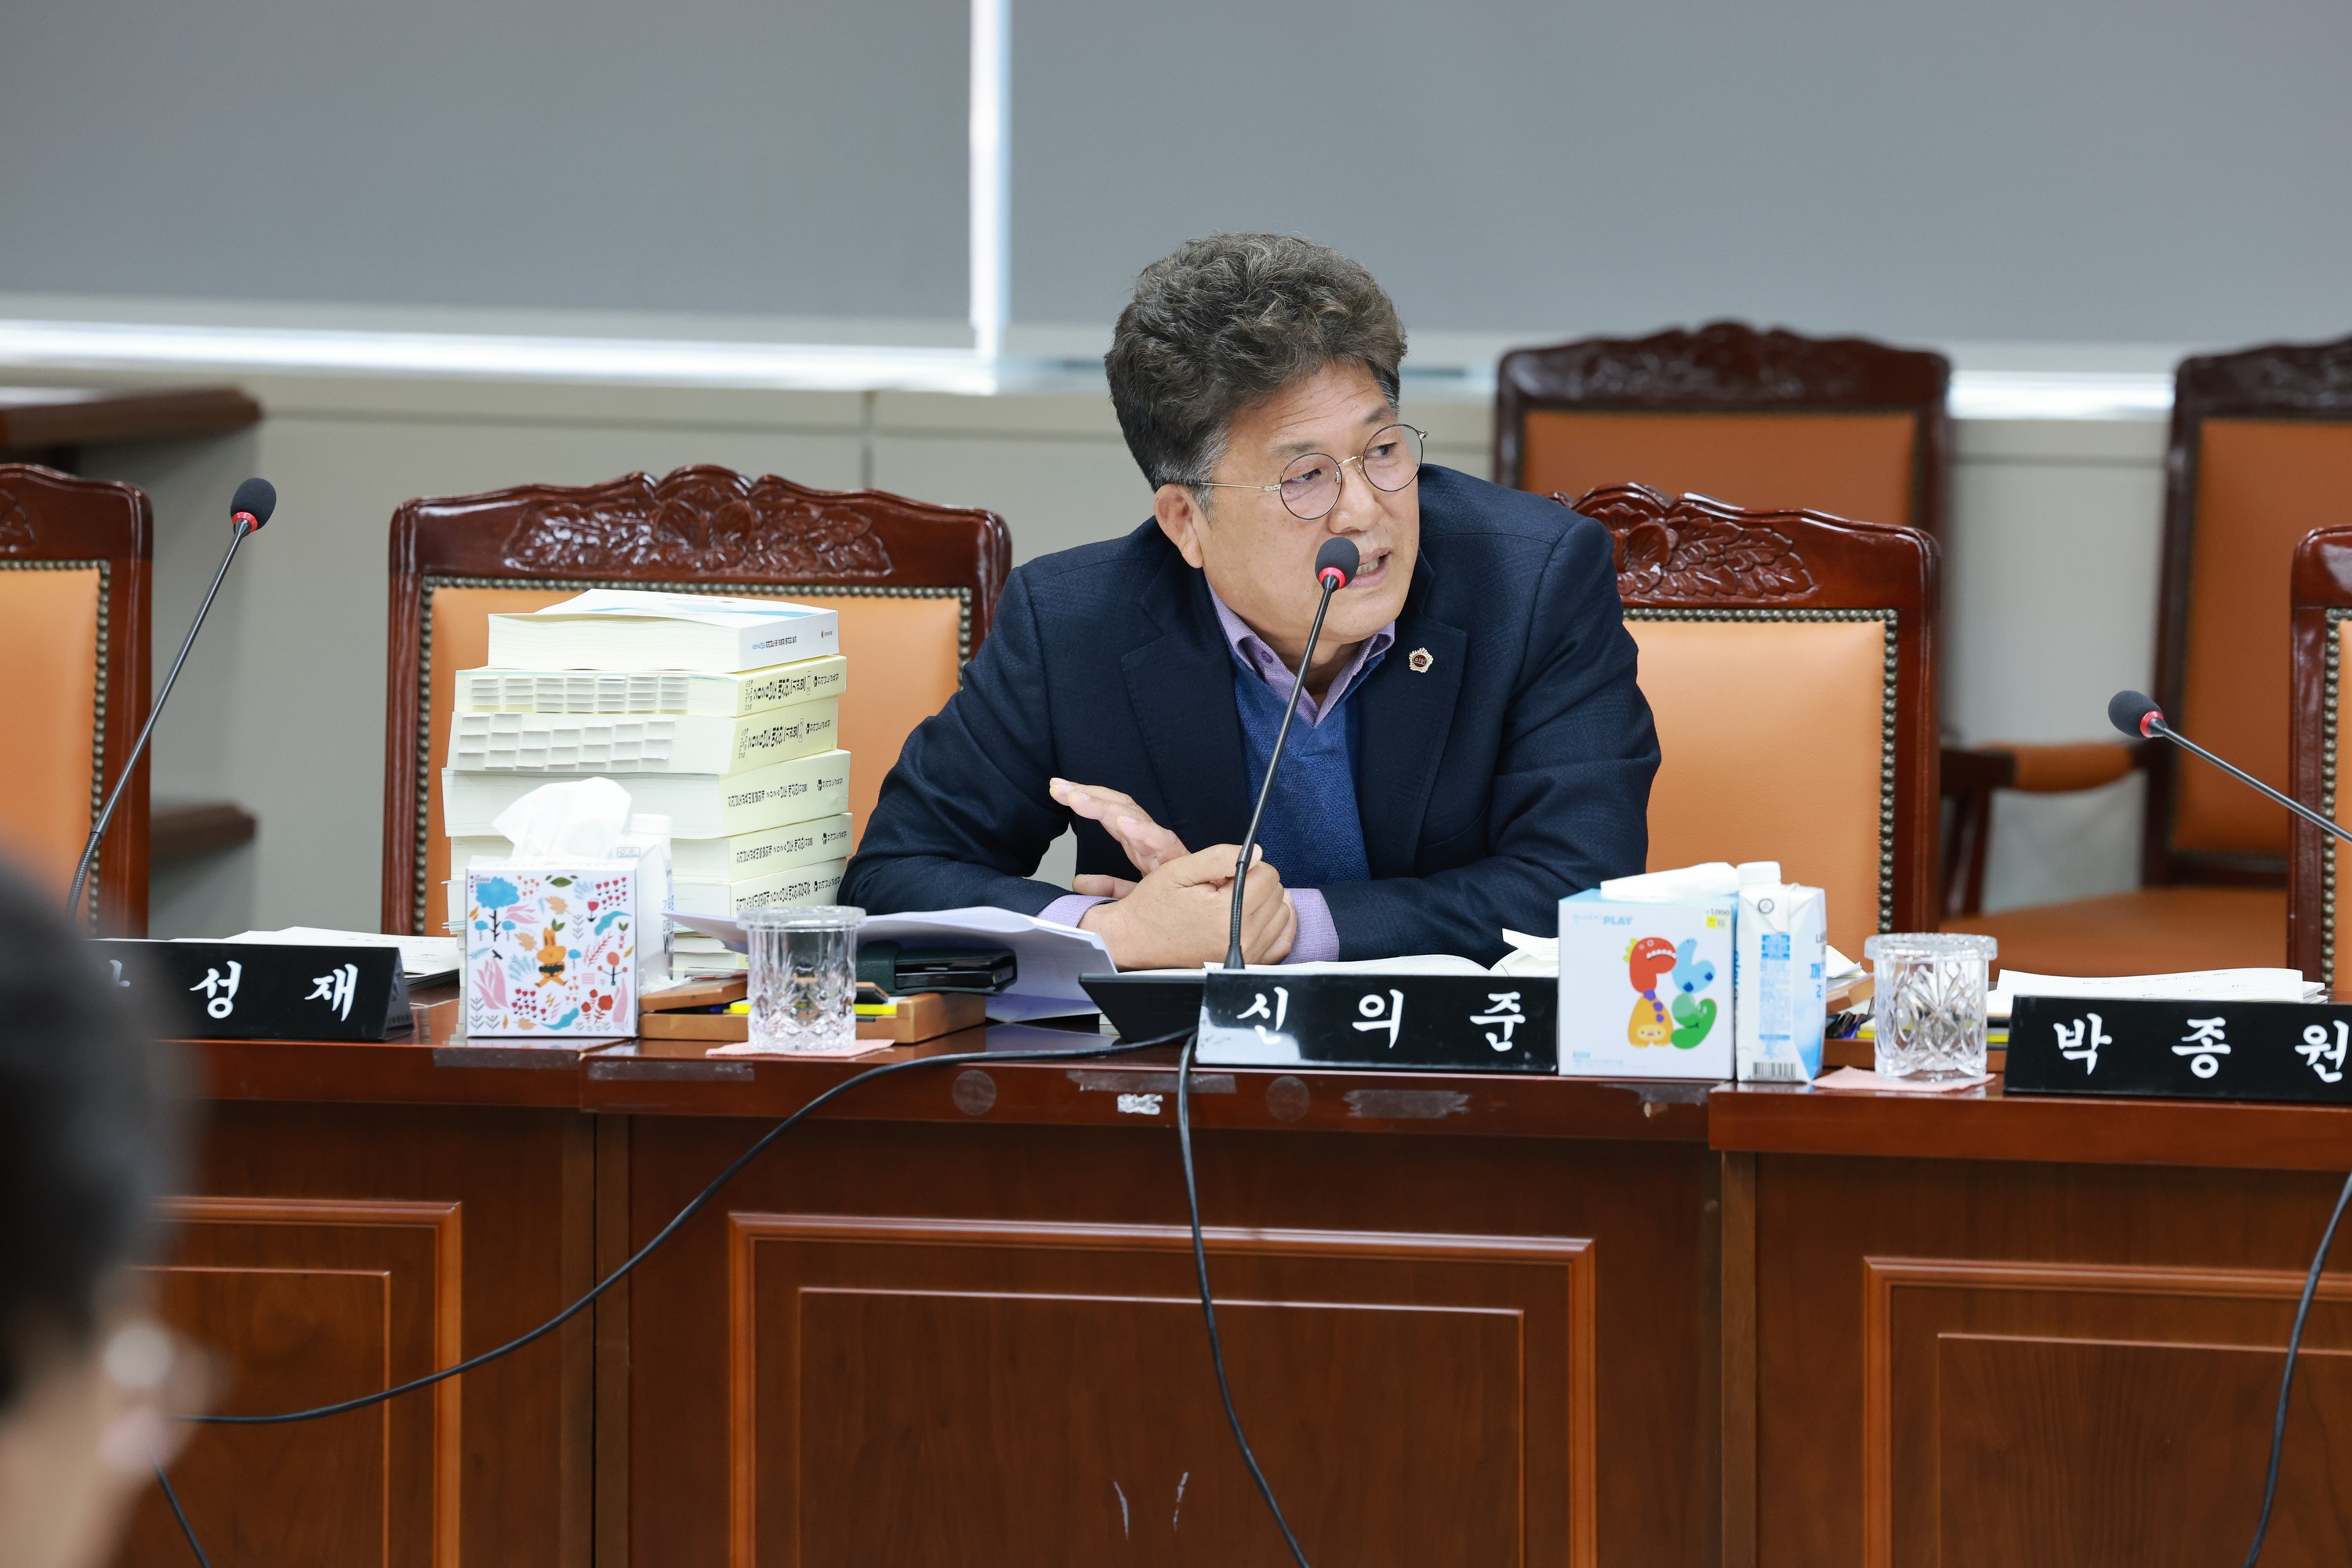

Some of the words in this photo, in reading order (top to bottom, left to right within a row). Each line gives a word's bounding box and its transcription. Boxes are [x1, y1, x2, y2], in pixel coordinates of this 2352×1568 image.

[1603, 916, 1632, 925] PLAY
[189, 960, 242, 1019] 성
[304, 964, 358, 1022] 재
[1236, 986, 1289, 1045] 신
[1352, 989, 1404, 1049] 의
[1469, 991, 1526, 1052] 준
[2053, 1013, 2113, 1075] 박
[2171, 1017, 2231, 1079] 종
[2295, 1020, 2350, 1083] 원
